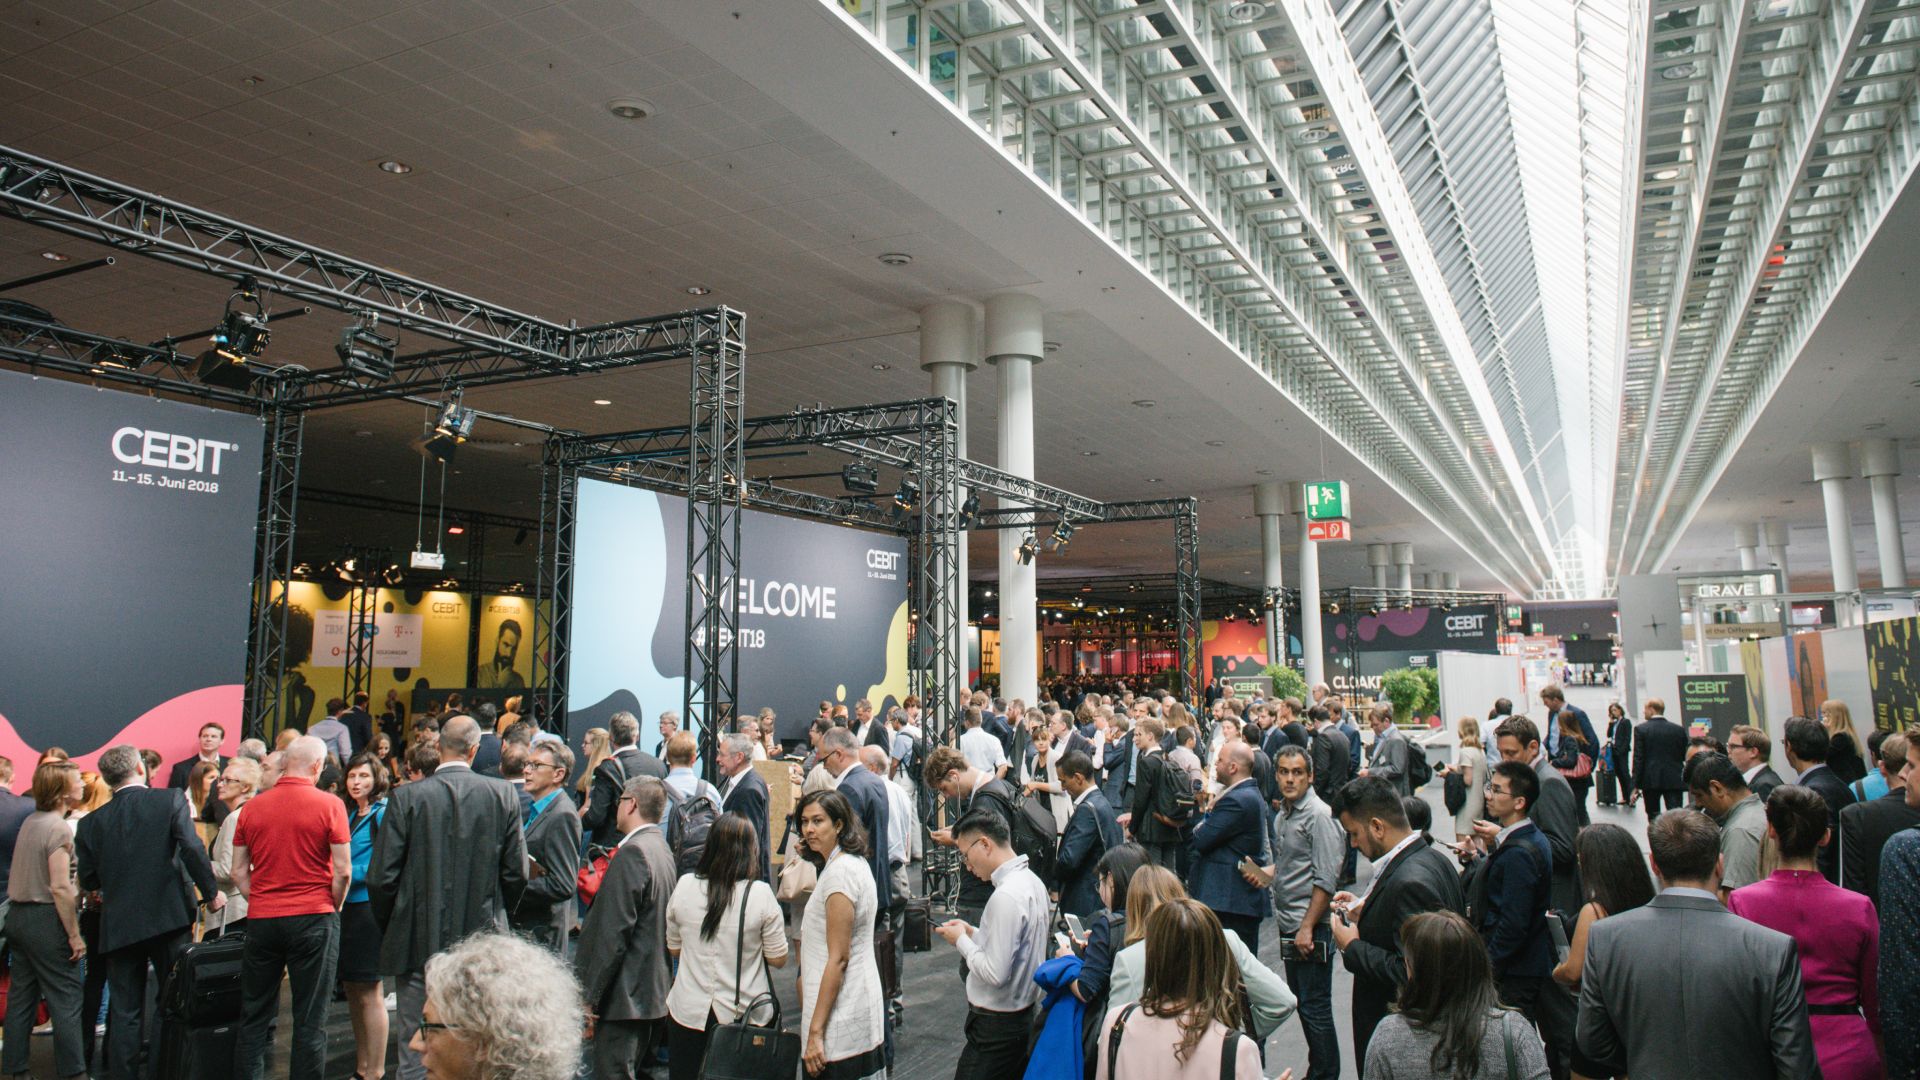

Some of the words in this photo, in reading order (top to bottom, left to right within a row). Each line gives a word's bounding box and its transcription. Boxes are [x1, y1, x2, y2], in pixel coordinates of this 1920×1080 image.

[157, 475, 186, 490] Juni
[187, 479, 219, 494] 2018
[431, 601, 463, 614] CEBIT
[324, 624, 345, 635] IBM
[1444, 614, 1489, 631] CEBIT
[1683, 680, 1731, 695] CEBIT
